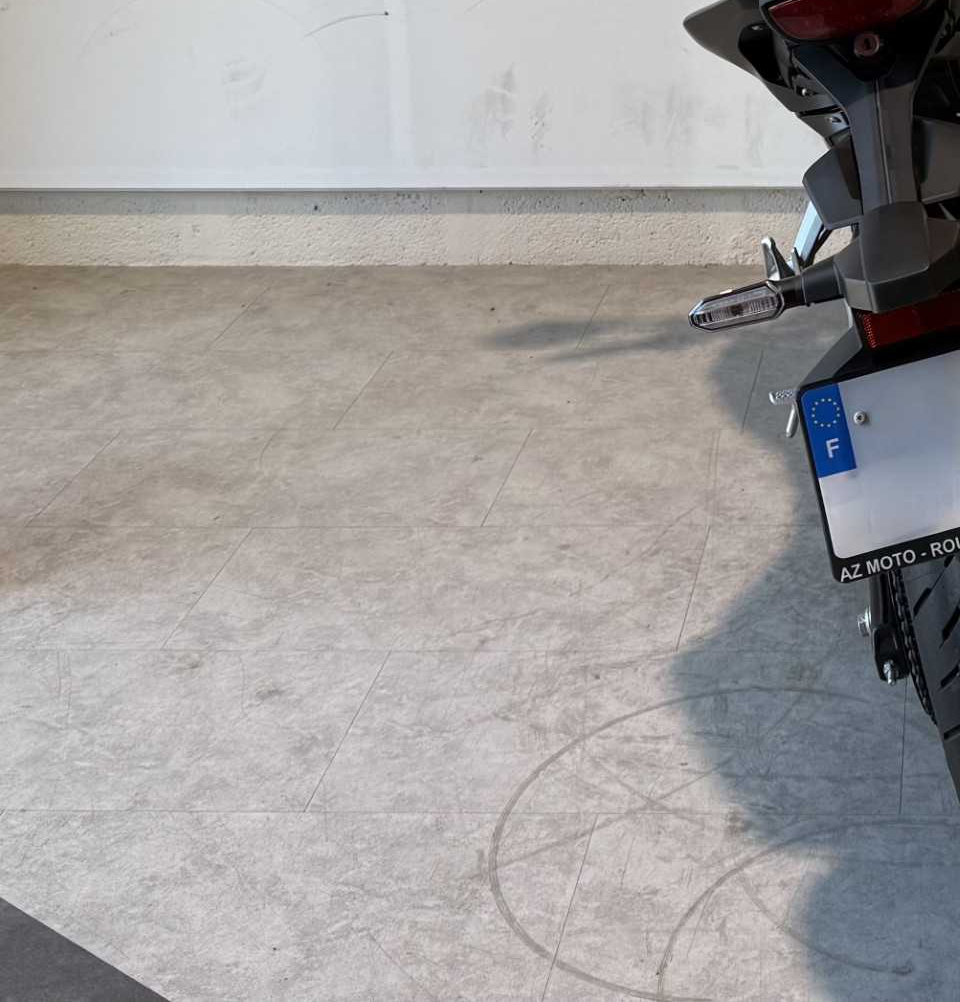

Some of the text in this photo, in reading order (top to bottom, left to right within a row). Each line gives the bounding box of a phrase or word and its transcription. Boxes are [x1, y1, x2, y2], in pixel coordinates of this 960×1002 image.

[826, 438, 839, 458] F
[840, 565, 863, 582] AZ
[866, 549, 916, 575] MOTO
